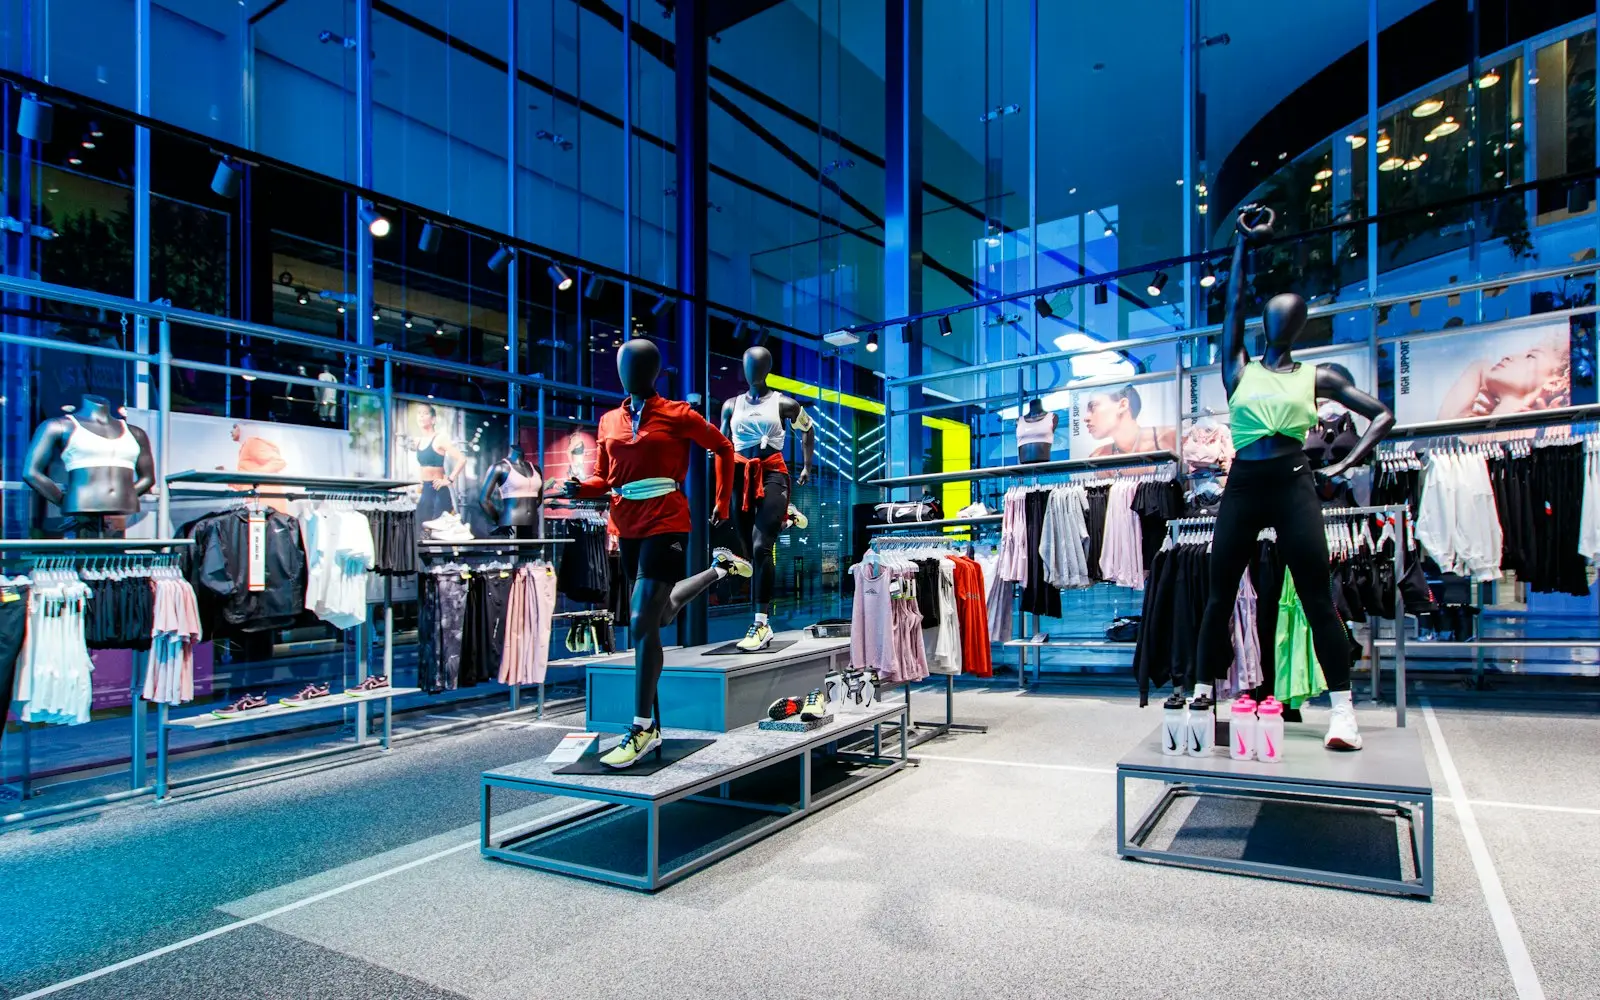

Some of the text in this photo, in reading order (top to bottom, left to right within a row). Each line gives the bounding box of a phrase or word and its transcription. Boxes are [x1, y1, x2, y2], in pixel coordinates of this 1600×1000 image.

[1190, 374, 1198, 405] SUPPORT
[1400, 339, 1410, 396] HIGH SUPPORT
[1072, 391, 1080, 437] LIGHT SUPPOR
